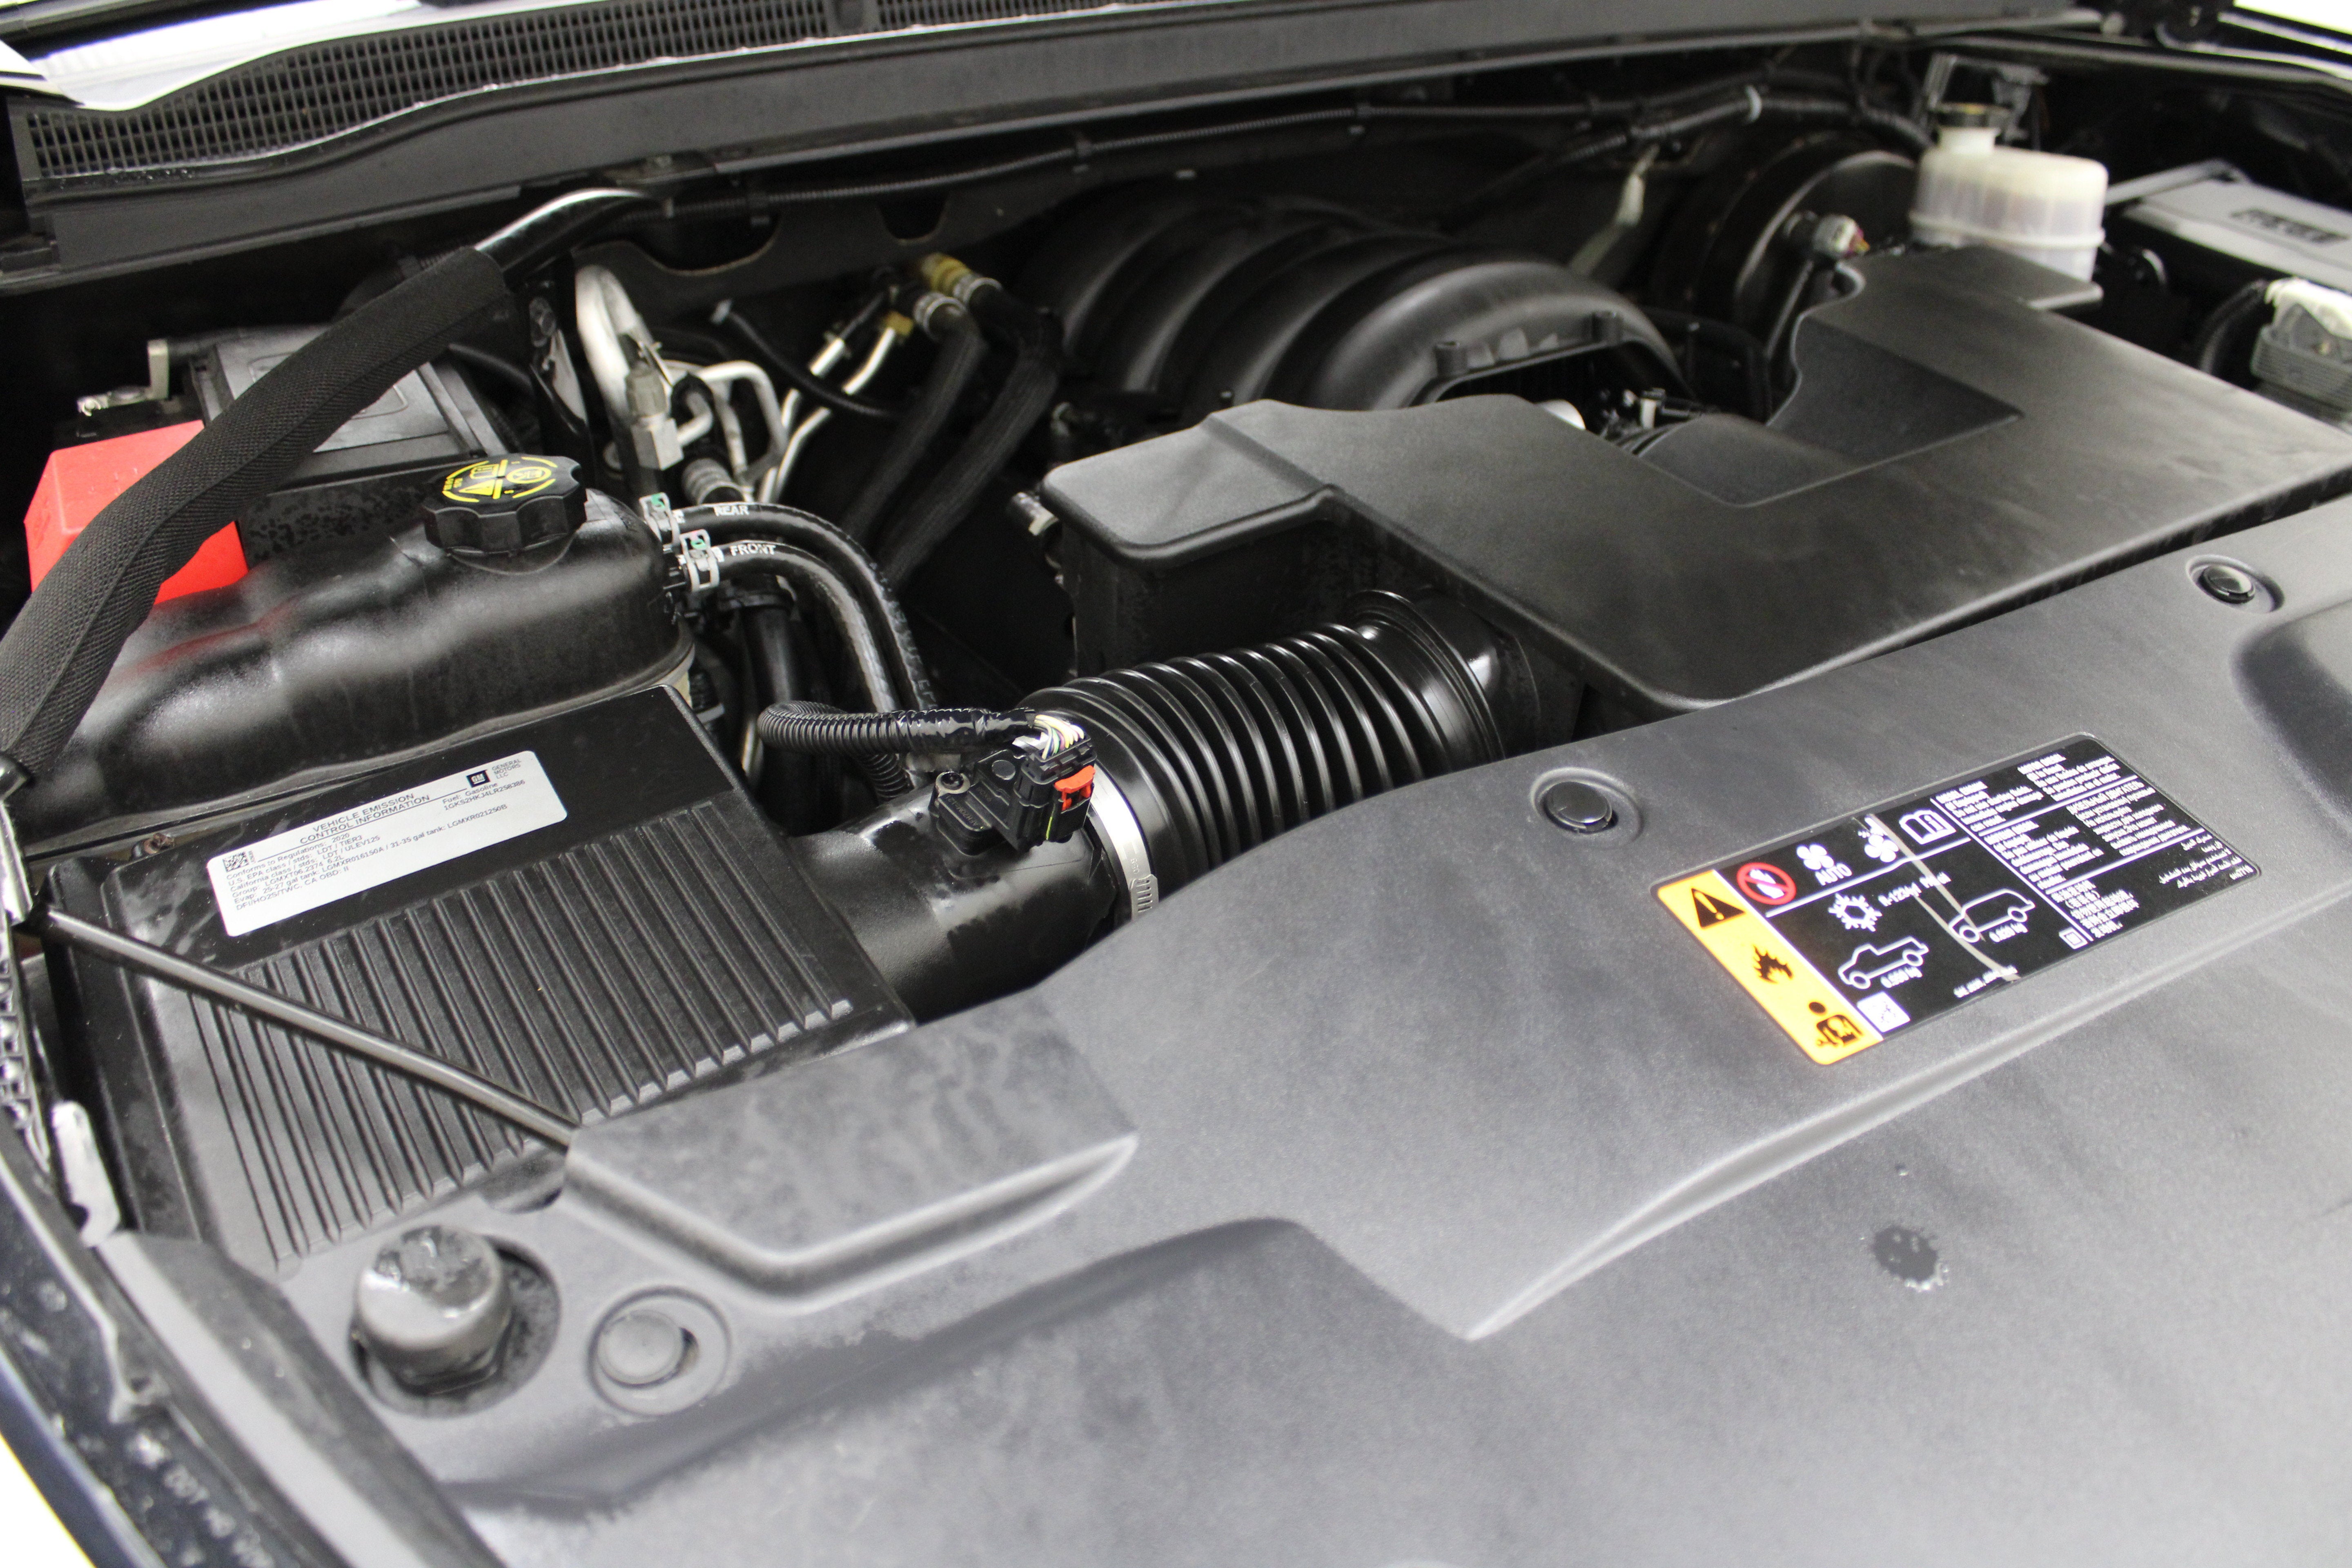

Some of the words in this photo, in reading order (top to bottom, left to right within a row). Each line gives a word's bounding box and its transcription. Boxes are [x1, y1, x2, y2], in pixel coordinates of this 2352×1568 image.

[713, 506, 750, 517] REAR
[729, 545, 777, 557] FRONT
[491, 758, 522, 772] GENERAL
[492, 762, 521, 775] MOTORS
[495, 771, 509, 780] LLC
[441, 794, 462, 804] Fuel:
[464, 782, 498, 797] Gasoline
[299, 822, 354, 844] CONTROL
[354, 794, 430, 825] INFORMATION
[312, 811, 360, 832] VEHICLE
[361, 793, 414, 816] EMISSION
[226, 863, 266, 880] Conforms
[277, 841, 327, 862] Regulations:
[331, 832, 350, 843] 2020
[230, 875, 270, 892] California
[270, 867, 292, 878] class
[298, 858, 318, 868] stds:
[322, 849, 338, 860] LDT
[344, 835, 381, 852] ULEV125
[234, 893, 256, 904] Evap:
[262, 882, 283, 894] 25-27
[285, 876, 298, 887] gal
[299, 870, 320, 880] tank:
[390, 836, 412, 848] 31-35
[412, 831, 425, 842] gal
[425, 825, 446, 836] tank:
[246, 870, 263, 880] EPA
[265, 862, 286, 873] class
[292, 853, 312, 864] stds:
[316, 844, 332, 855] LDT
[338, 834, 363, 846] TIER3
[232, 886, 258, 898] Group:
[326, 854, 344, 864] 6.2L
[304, 877, 317, 885] CA
[319, 869, 341, 880] OBD:
[1814, 862, 1852, 886] AUTO
